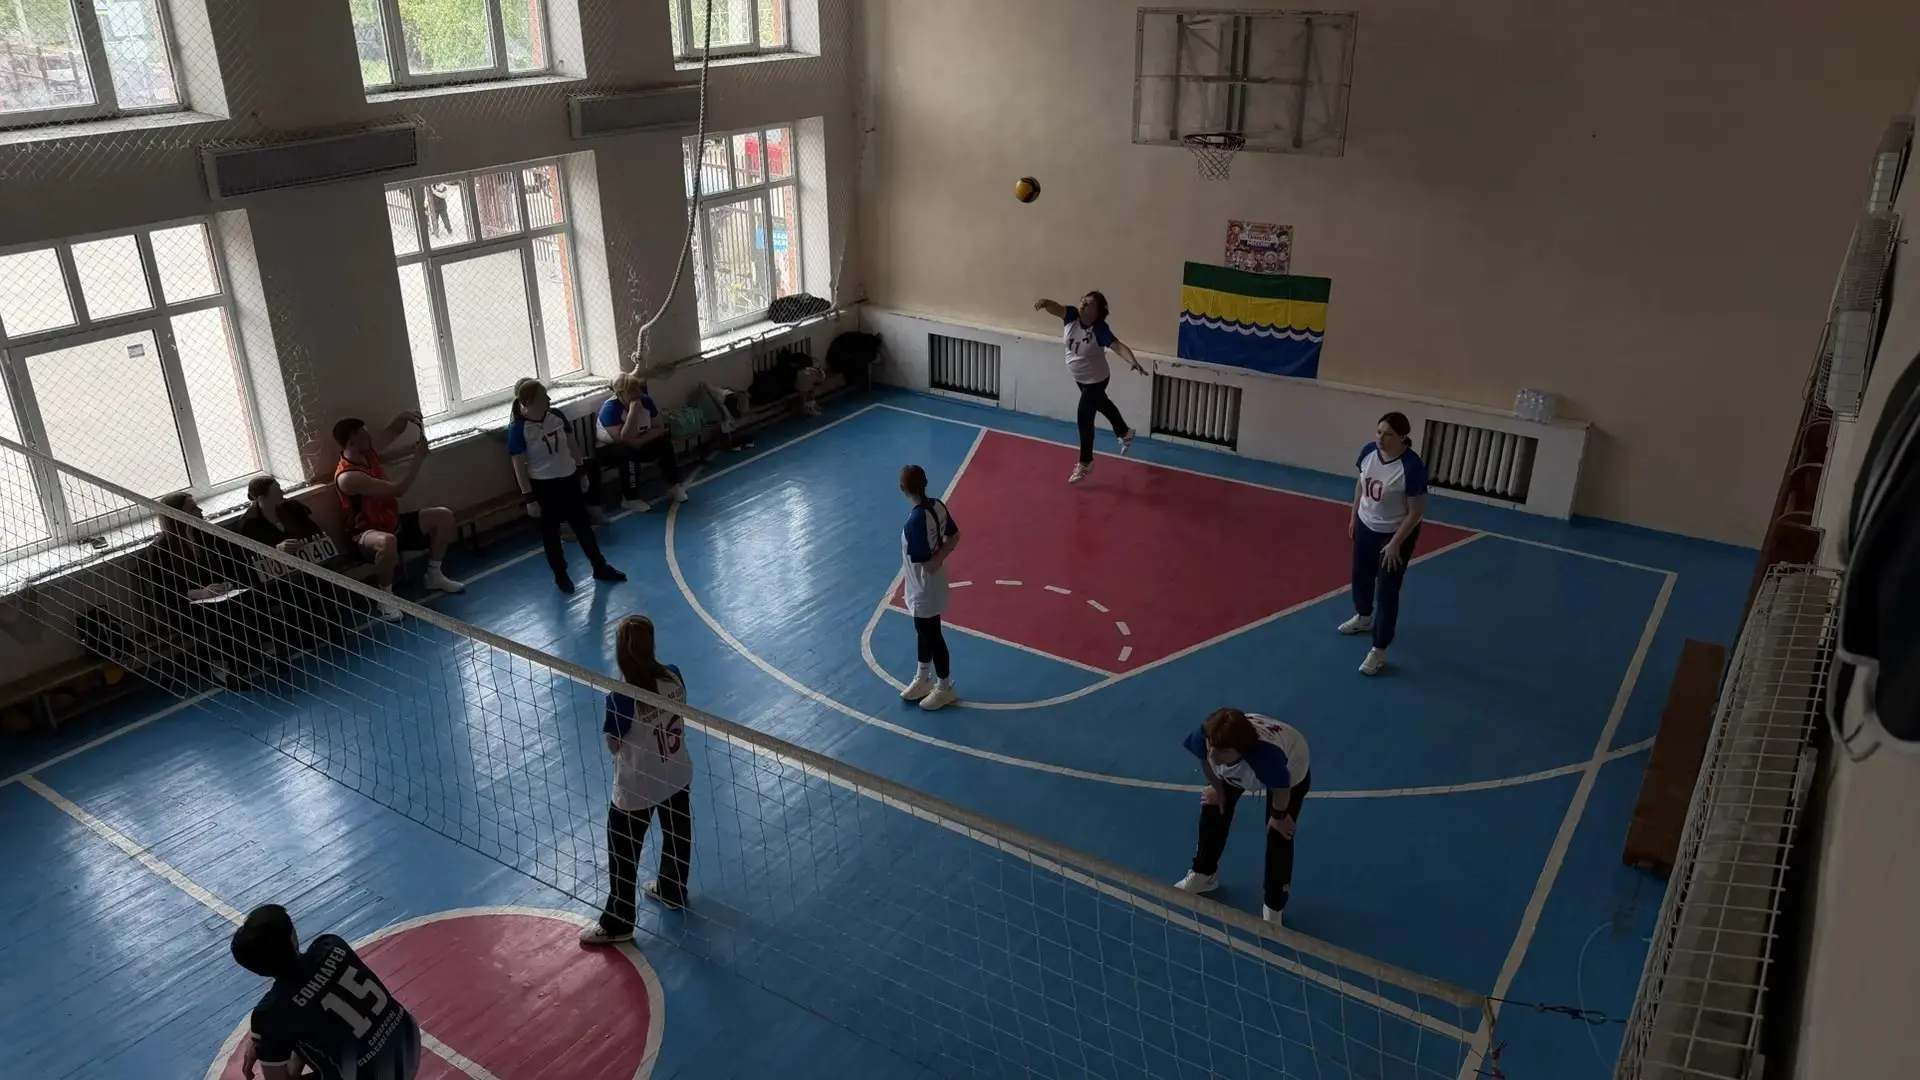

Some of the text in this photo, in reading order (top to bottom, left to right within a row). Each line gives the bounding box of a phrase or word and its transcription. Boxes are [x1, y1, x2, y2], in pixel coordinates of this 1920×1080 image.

[542, 430, 559, 455] 17
[1365, 476, 1383, 502] 10
[653, 714, 681, 763] 16
[292, 946, 347, 1007] БОНДАРЕВ
[320, 965, 387, 1039] 15
